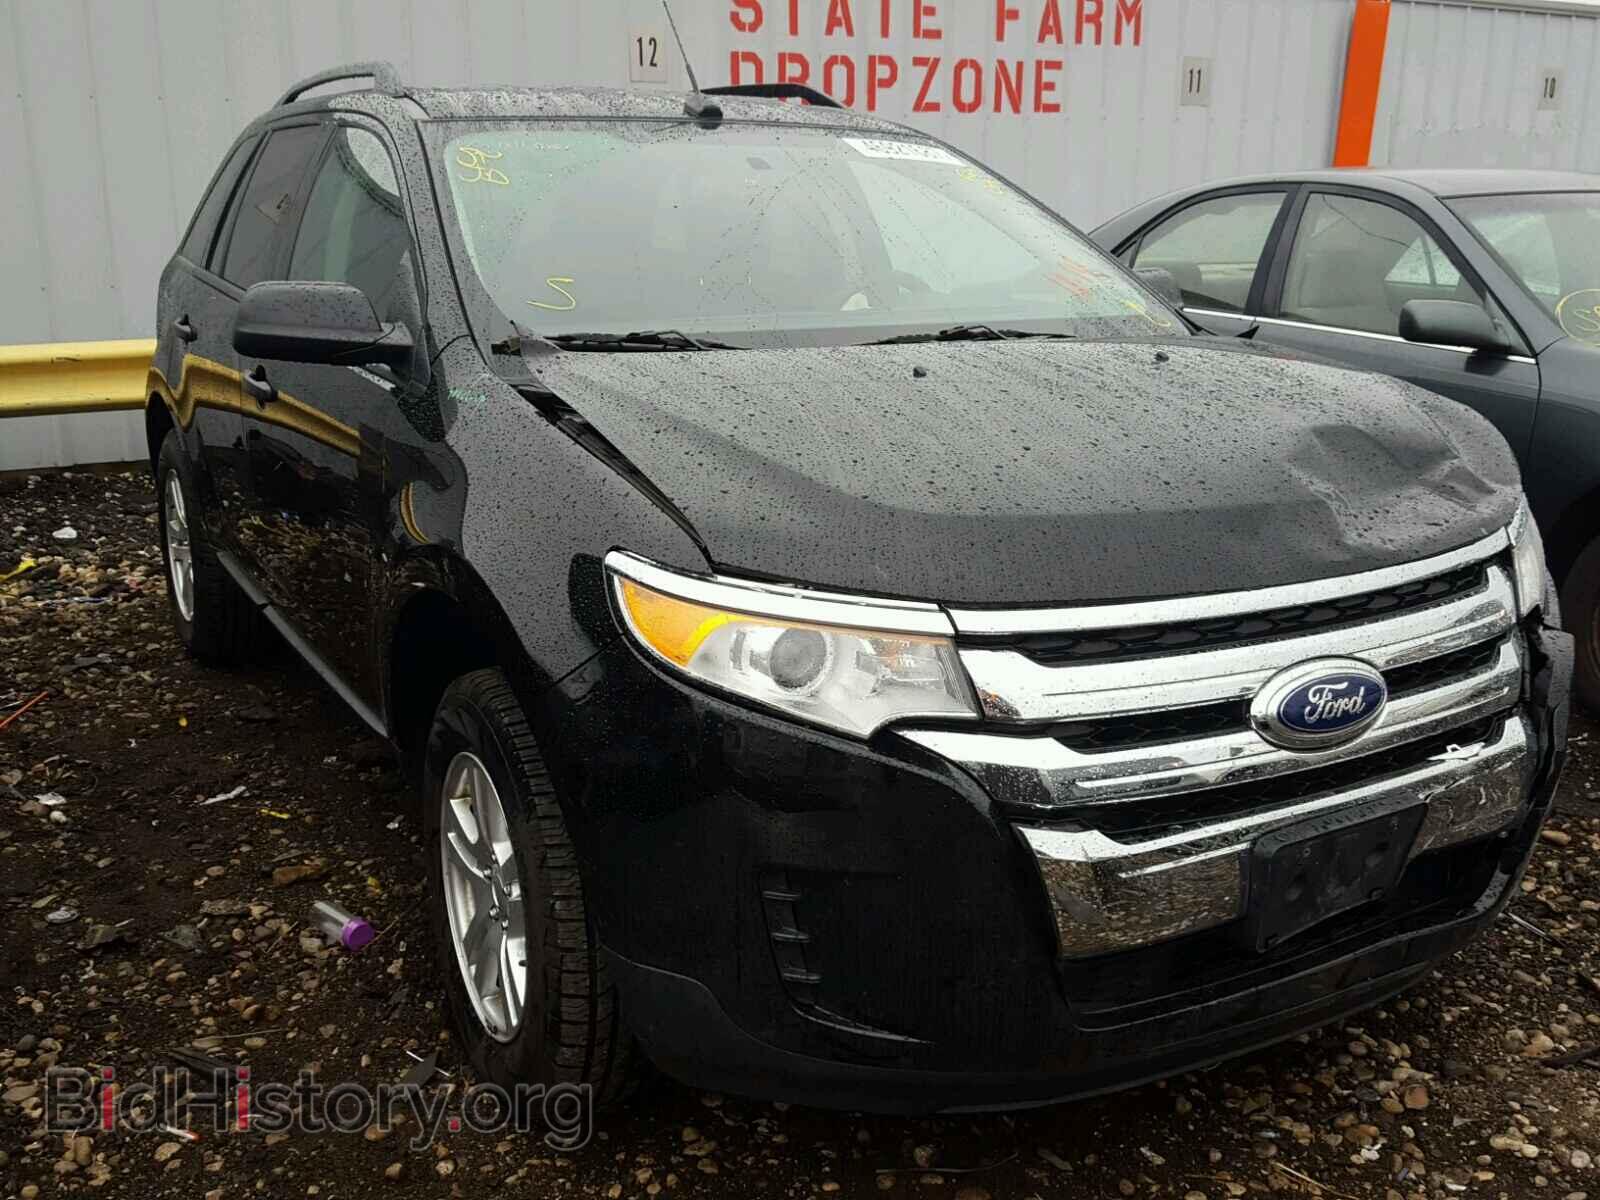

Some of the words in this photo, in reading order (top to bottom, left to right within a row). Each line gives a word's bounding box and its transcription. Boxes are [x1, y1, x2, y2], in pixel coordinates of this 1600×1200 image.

[995, 0, 1144, 47] FARM
[635, 36, 658, 68] 12
[729, 50, 1064, 114] DROPZONE
[1188, 67, 1202, 94] 11
[1543, 76, 1557, 99] 10
[1303, 681, 1367, 724] Ford
